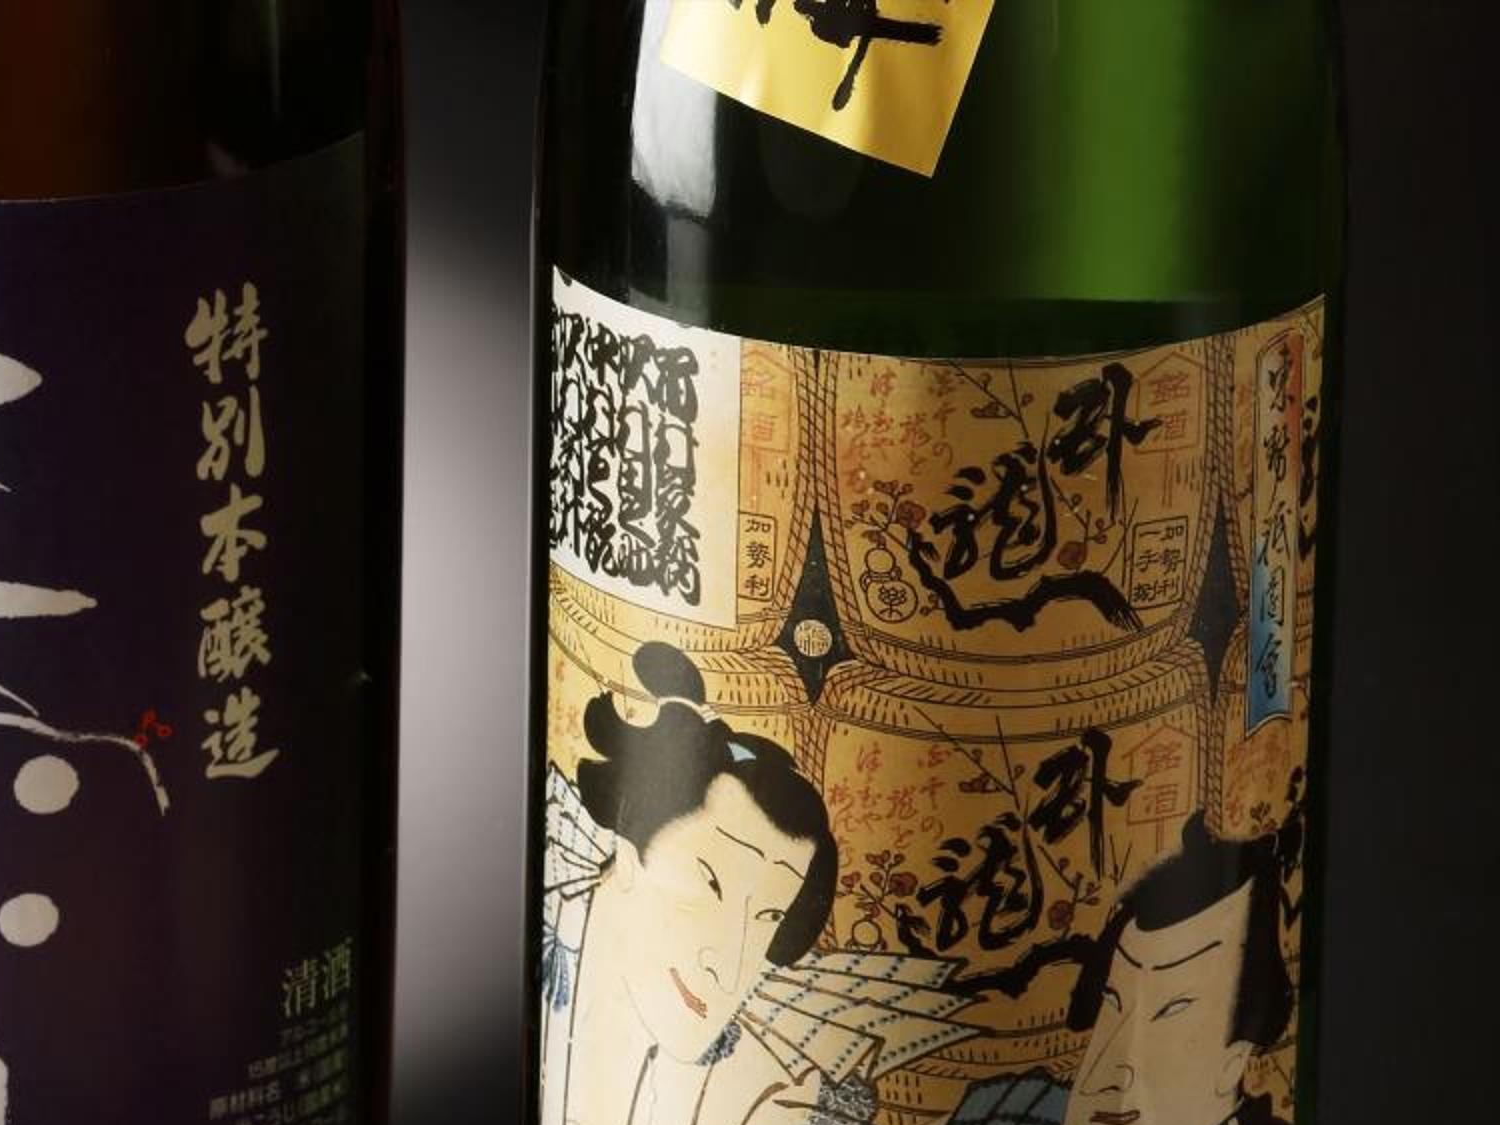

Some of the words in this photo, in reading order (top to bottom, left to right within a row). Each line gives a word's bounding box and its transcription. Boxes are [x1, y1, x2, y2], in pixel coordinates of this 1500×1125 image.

[185, 283, 279, 780] 特別本醸造
[281, 936, 353, 1019] 清酒
